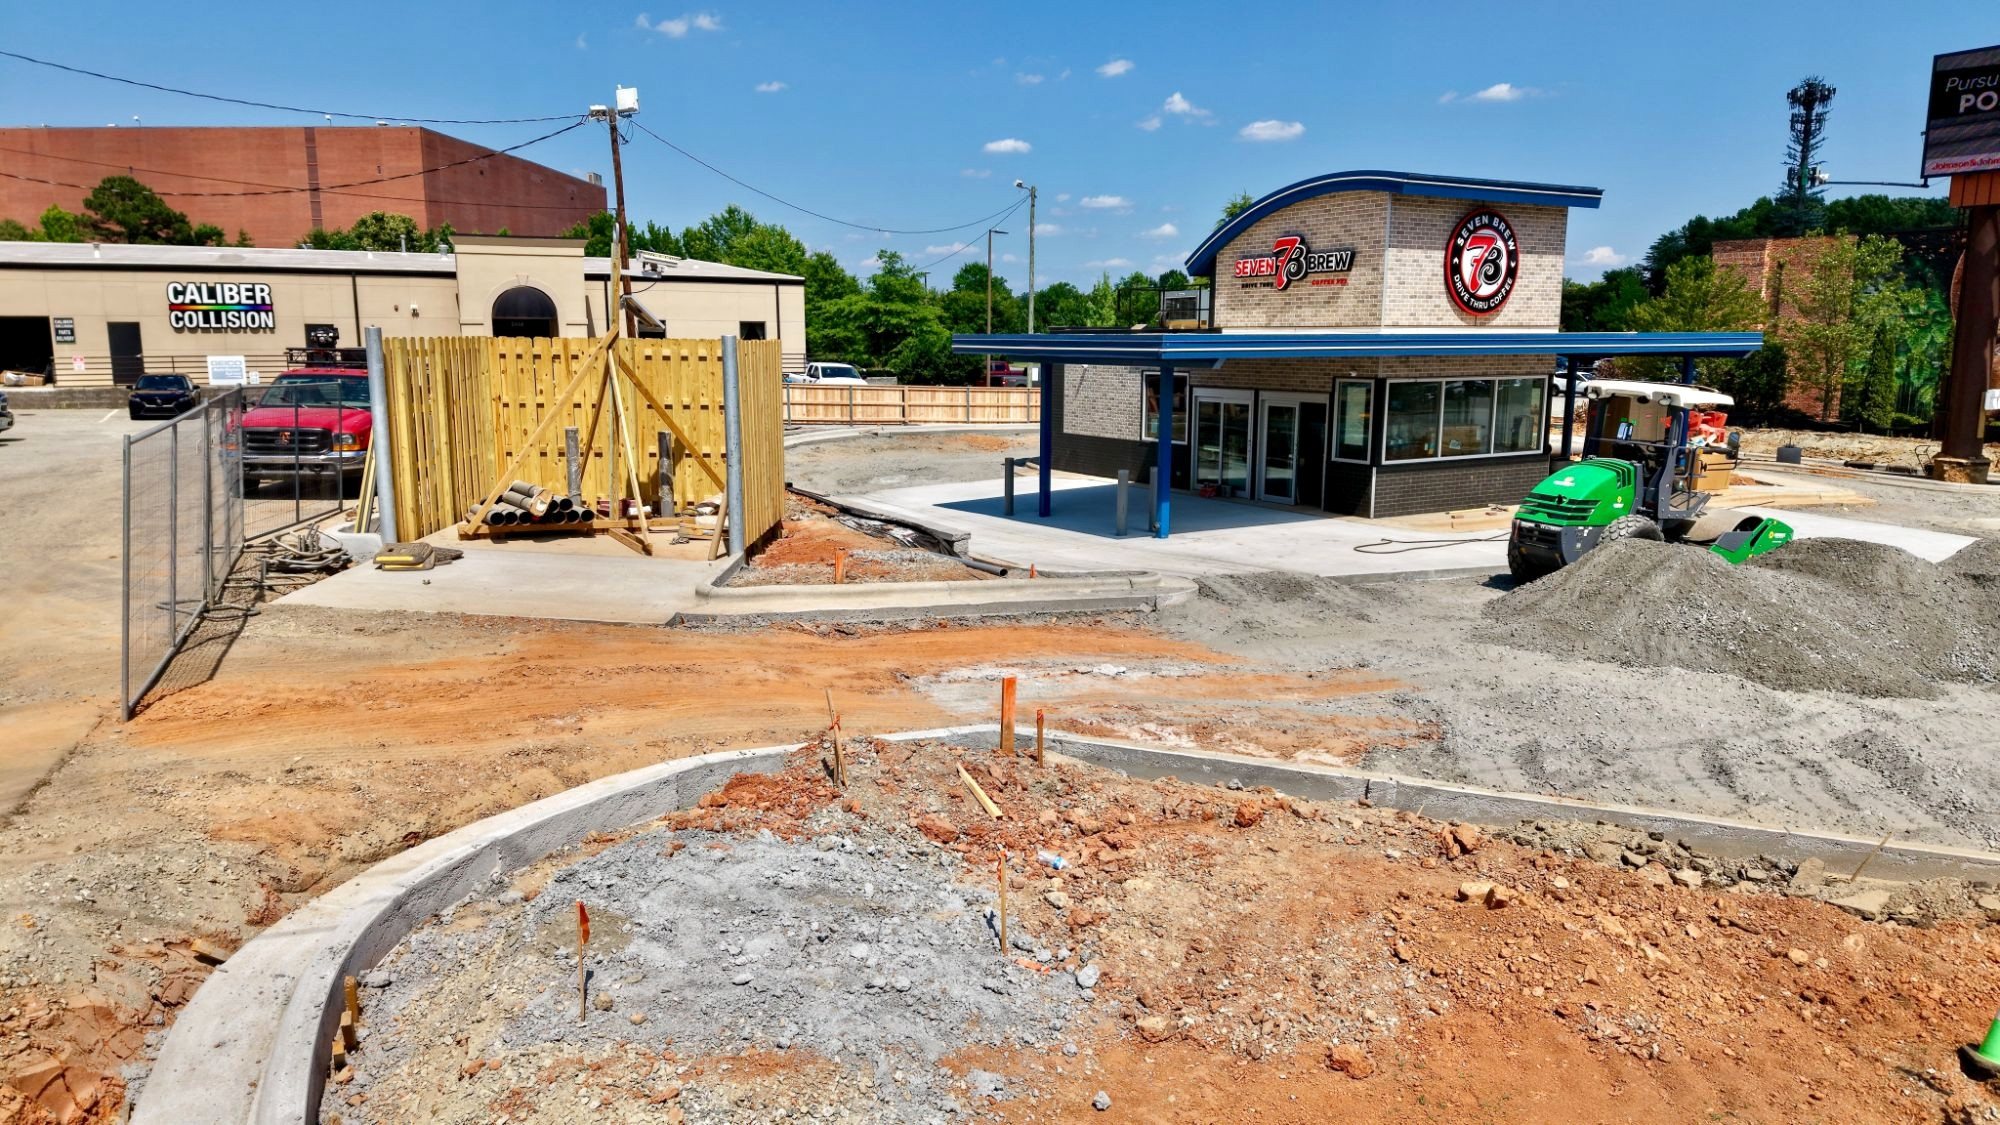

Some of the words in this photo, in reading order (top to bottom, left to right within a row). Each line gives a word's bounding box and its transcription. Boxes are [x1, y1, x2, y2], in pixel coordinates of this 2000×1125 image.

[1457, 215, 1489, 246] SEVEN
[1493, 217, 1516, 250] BREW
[1235, 258, 1276, 277] SEVEN
[1307, 251, 1351, 273] BREW
[167, 281, 272, 305] CALIBER
[1453, 274, 1471, 302] DRIVE
[1469, 297, 1488, 310] THRU
[1490, 277, 1513, 307] COFFEE
[169, 310, 275, 328] COLLISION
